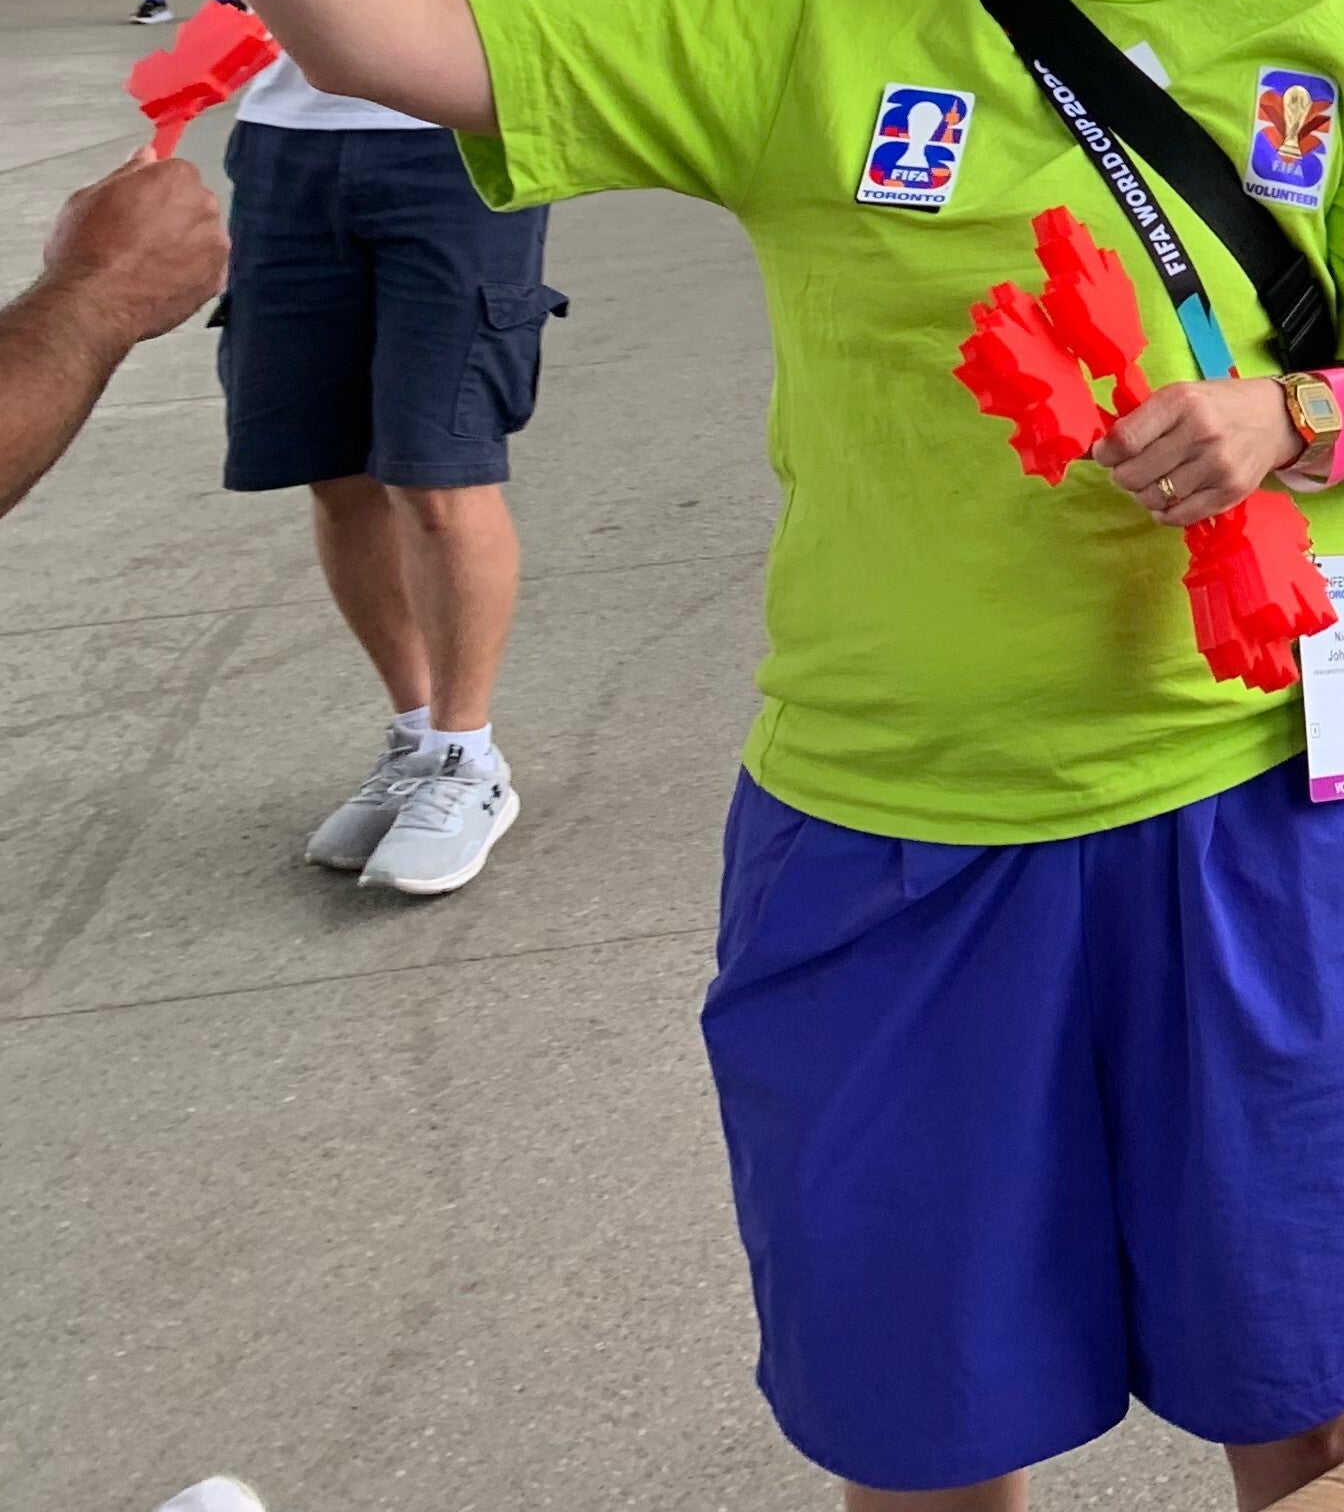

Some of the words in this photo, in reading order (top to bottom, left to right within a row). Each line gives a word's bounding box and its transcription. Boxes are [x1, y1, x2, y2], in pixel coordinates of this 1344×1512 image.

[1073, 118, 1112, 152] CUP
[890, 168, 930, 183] FIFA
[1271, 161, 1305, 179] FIFA
[862, 189, 946, 203] TORONTO
[1101, 151, 1159, 228] WORLD
[1245, 181, 1319, 207] VOLUNTEER
[1148, 223, 1187, 277] FIFA
